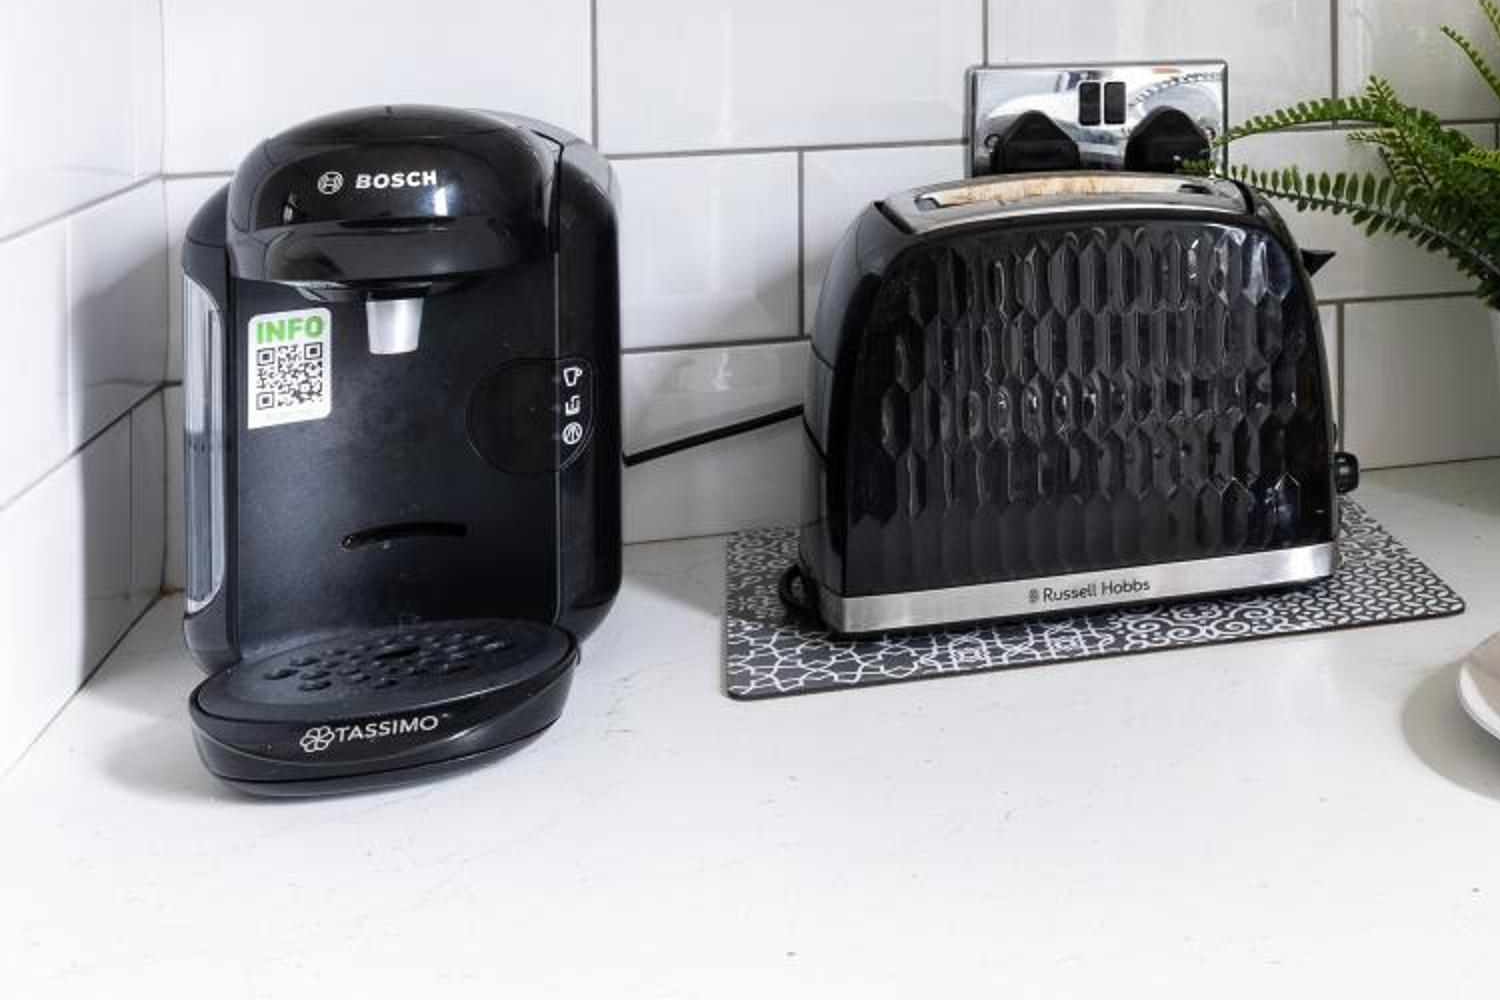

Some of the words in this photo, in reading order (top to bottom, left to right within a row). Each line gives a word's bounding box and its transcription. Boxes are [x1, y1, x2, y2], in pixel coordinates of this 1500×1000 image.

[355, 170, 437, 189] BOSCH
[256, 316, 323, 344] INFO
[1043, 583, 1097, 602] Russell
[1101, 579, 1151, 596] Hobbs
[336, 715, 439, 742] TASSIMO
